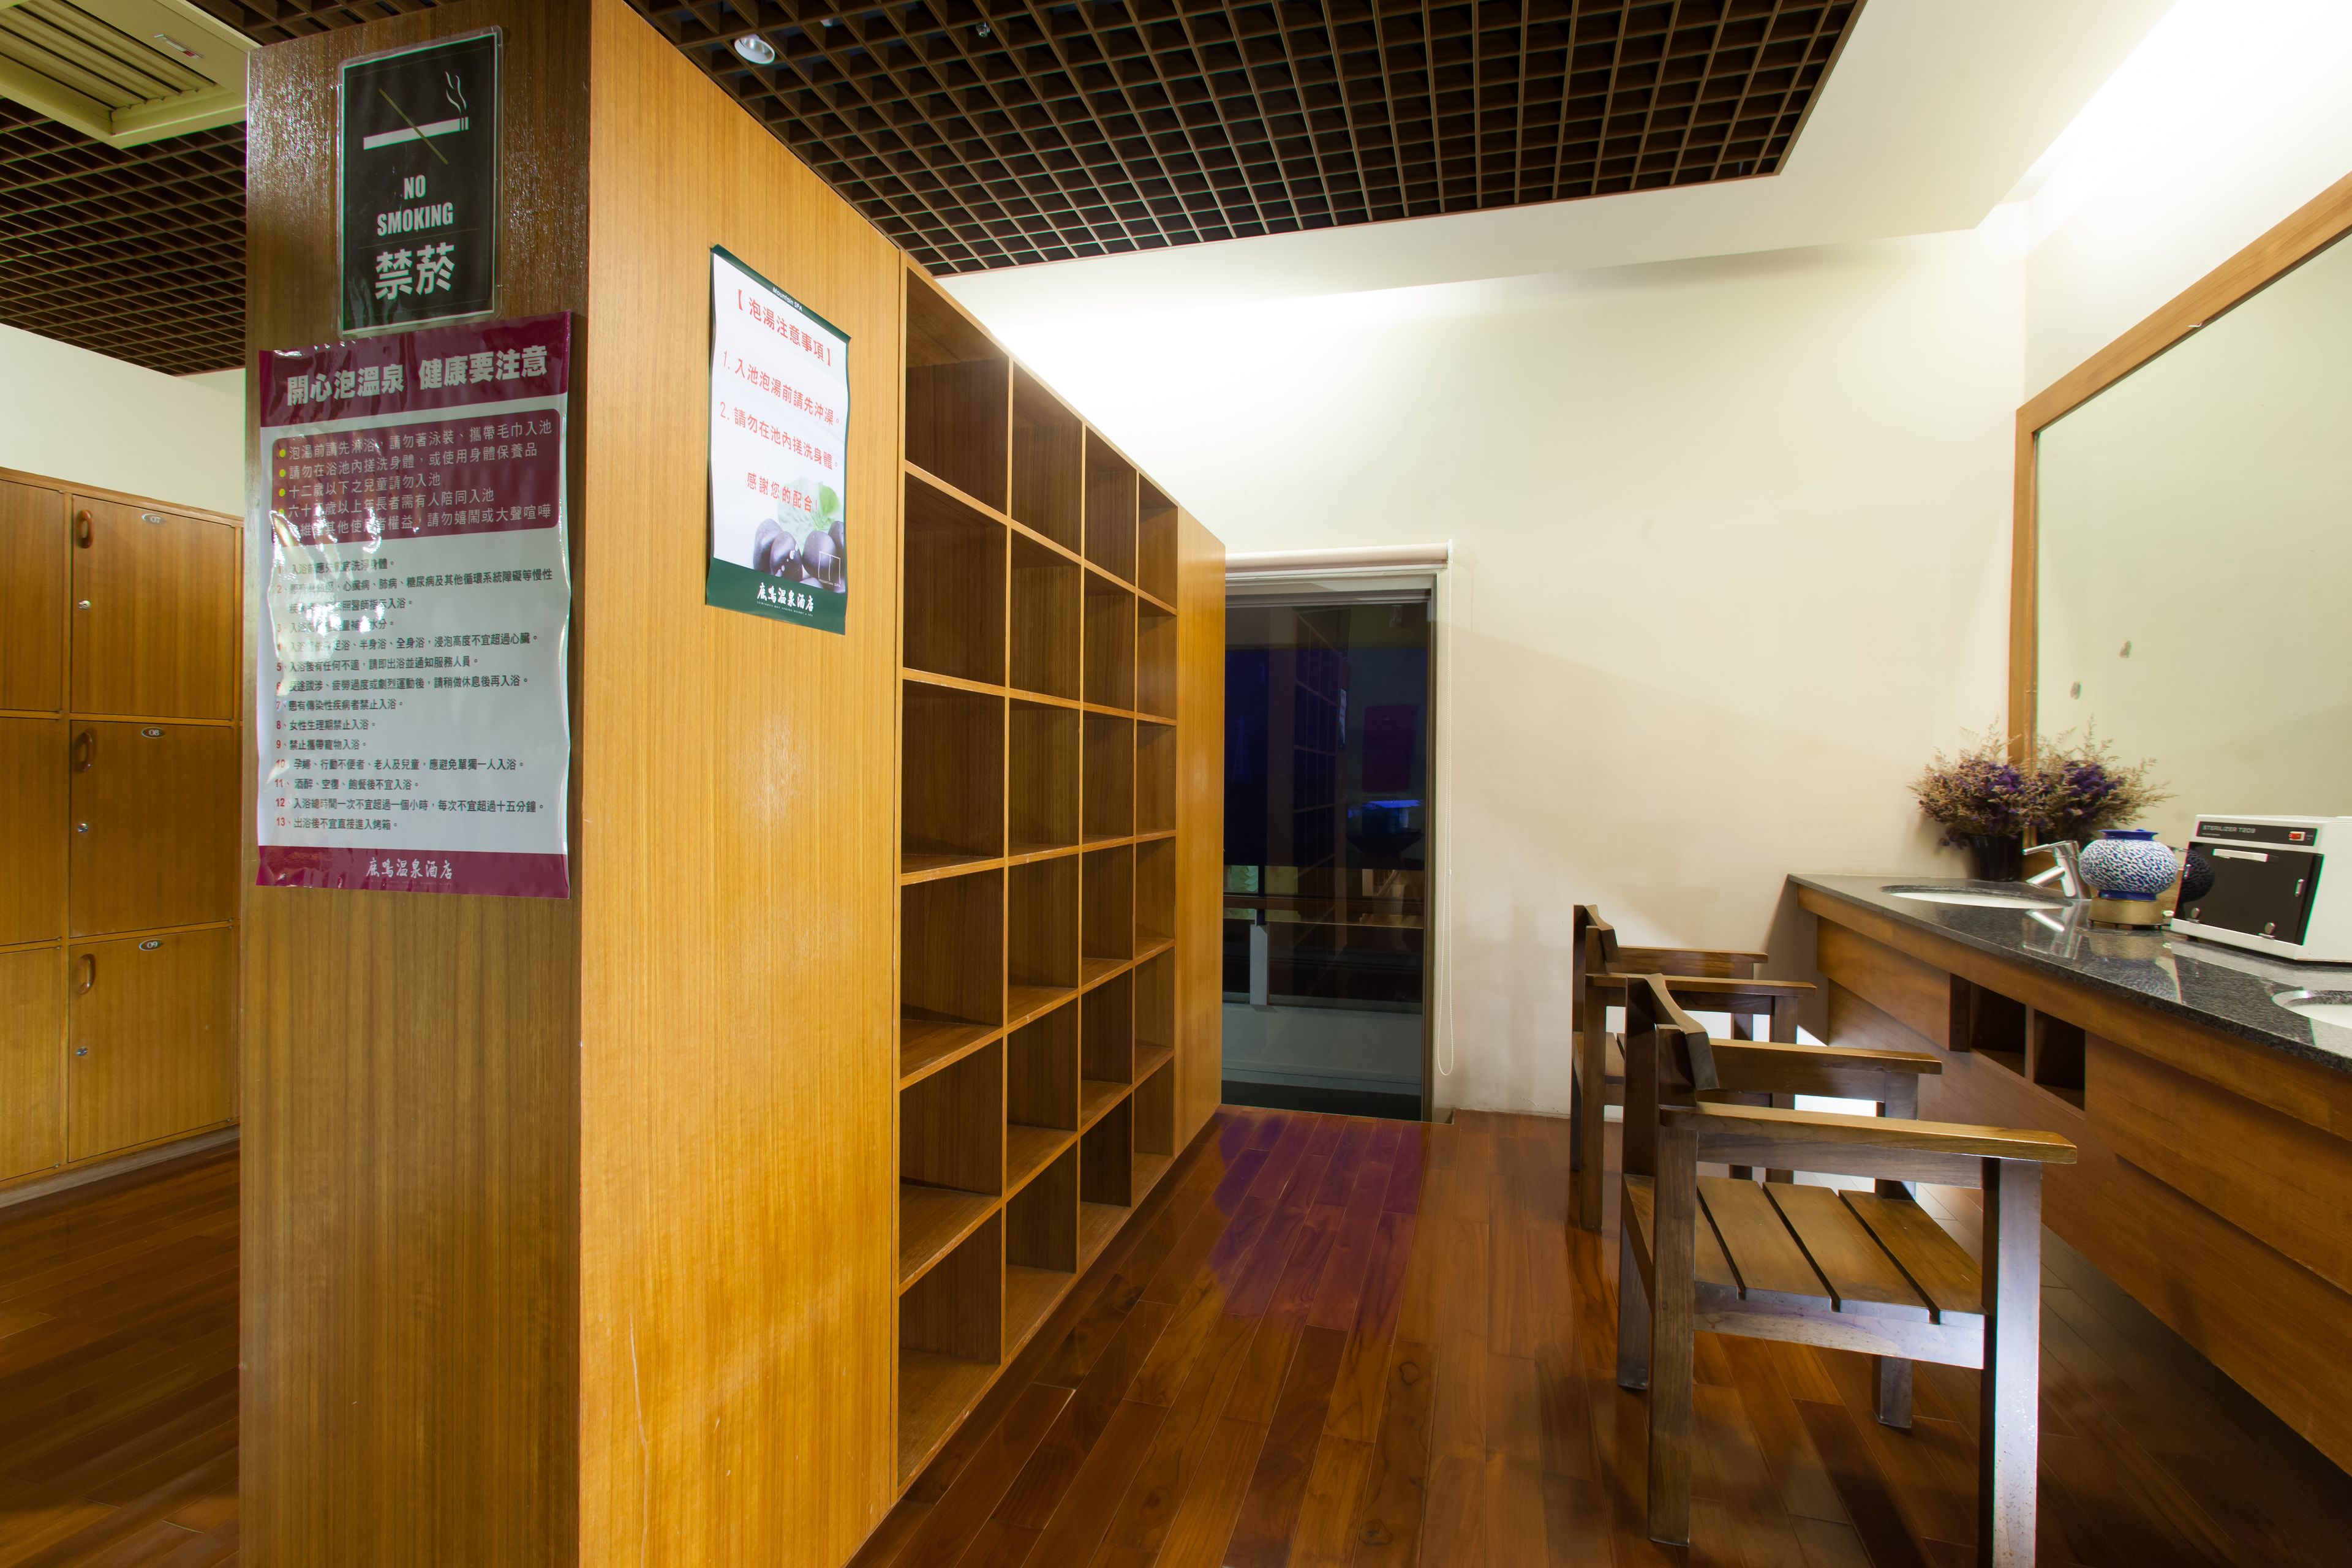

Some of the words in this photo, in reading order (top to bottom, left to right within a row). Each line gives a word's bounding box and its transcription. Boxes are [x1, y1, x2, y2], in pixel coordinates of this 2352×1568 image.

[404, 175, 426, 200] NO
[377, 202, 454, 236] SMOKING
[375, 242, 455, 300] 禁菸
[772, 287, 794, 306] Mountain
[794, 301, 802, 312] SPA
[287, 363, 404, 407] 開心泡溫泉
[418, 344, 548, 390] 健康要注意
[288, 472, 441, 499] 十二歲以下之兒童請勿入池
[288, 488, 494, 518] 六十歲以上年長者需有人陪同入池
